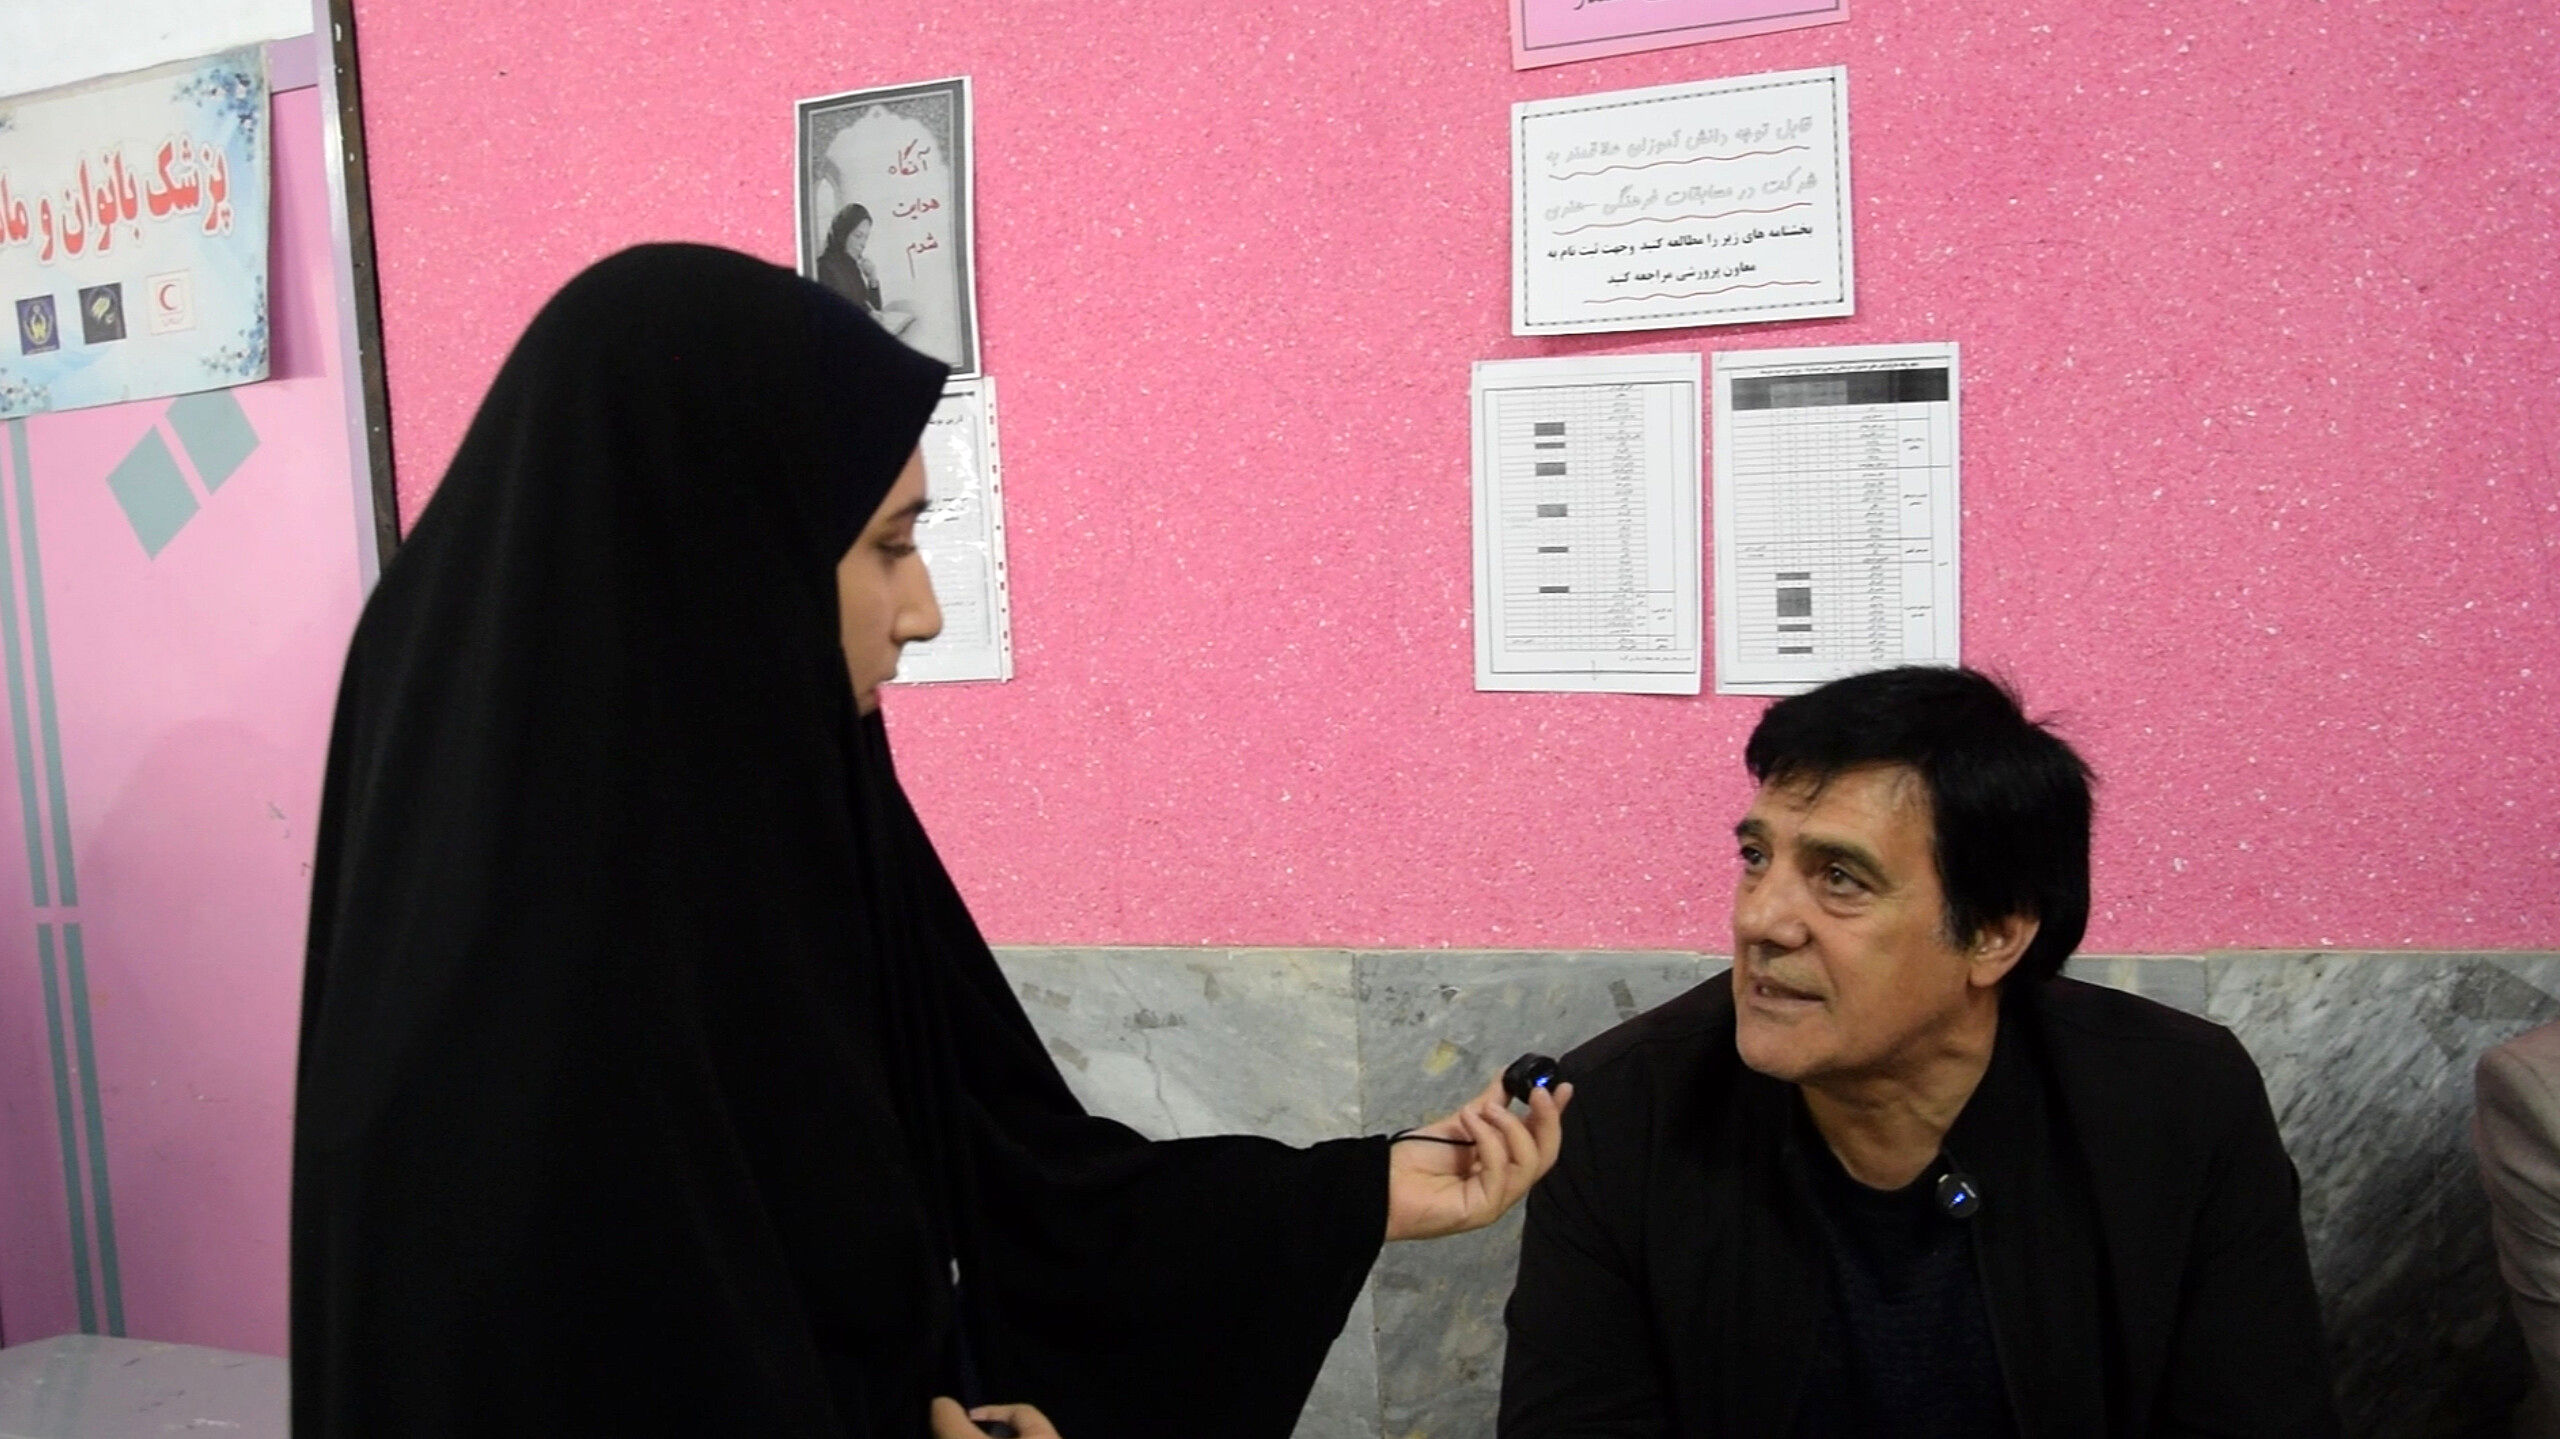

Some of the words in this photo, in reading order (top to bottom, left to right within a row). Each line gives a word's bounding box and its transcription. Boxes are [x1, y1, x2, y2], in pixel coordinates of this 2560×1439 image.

[1735, 122, 1770, 143] توجه
[1776, 116, 1813, 140] قابل
[1626, 129, 1681, 158] آموزان
[1686, 128, 1728, 150] دانش
[888, 138, 931, 176] آنگاه
[146, 139, 231, 230] پزشک
[1761, 166, 1817, 194] شرکت
[62, 150, 140, 255] بانوان
[1602, 184, 1658, 215] فرهنگی
[1664, 185, 1732, 206] مسابقات
[1737, 186, 1755, 200] در
[0, 172, 29, 244] ما
[892, 198, 941, 219] هدایت
[41, 198, 54, 261] و
[1706, 233, 1718, 247] را
[1721, 232, 1739, 247] زیر
[1742, 228, 1764, 244] های
[1769, 223, 1813, 237] بخشنامه
[1579, 242, 1599, 258] ثبت
[1640, 237, 1663, 253] کنید
[1667, 234, 1704, 247] مطالعه
[905, 231, 939, 279] شدم
[1560, 244, 1576, 261] نام
[1607, 270, 1631, 286] کنید
[1634, 269, 1673, 284] مراجعه
[1675, 266, 1720, 281] پرورشی
[1723, 261, 1756, 277] معاون
